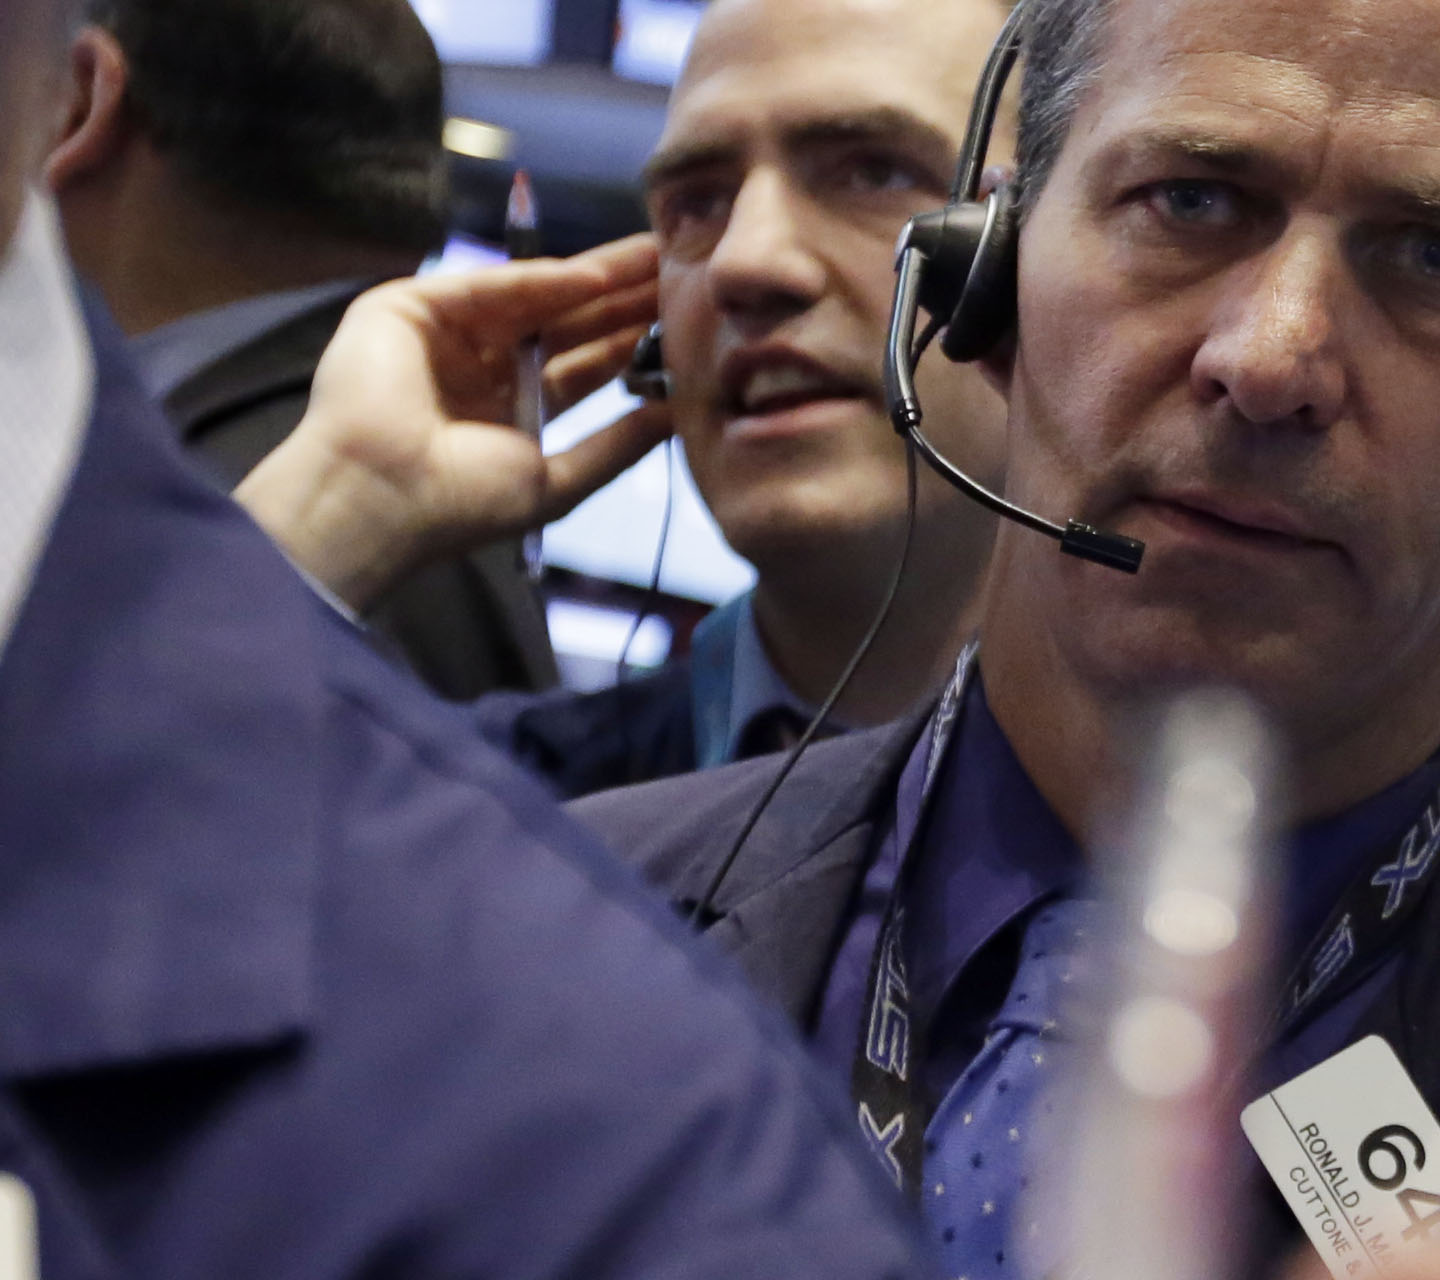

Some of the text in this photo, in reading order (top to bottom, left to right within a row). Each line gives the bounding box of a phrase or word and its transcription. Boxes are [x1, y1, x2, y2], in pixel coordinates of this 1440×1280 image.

[1289, 1166, 1353, 1257] CUTTONE
[1298, 1122, 1360, 1208] RONALD
[1353, 1215, 1373, 1234] J.
